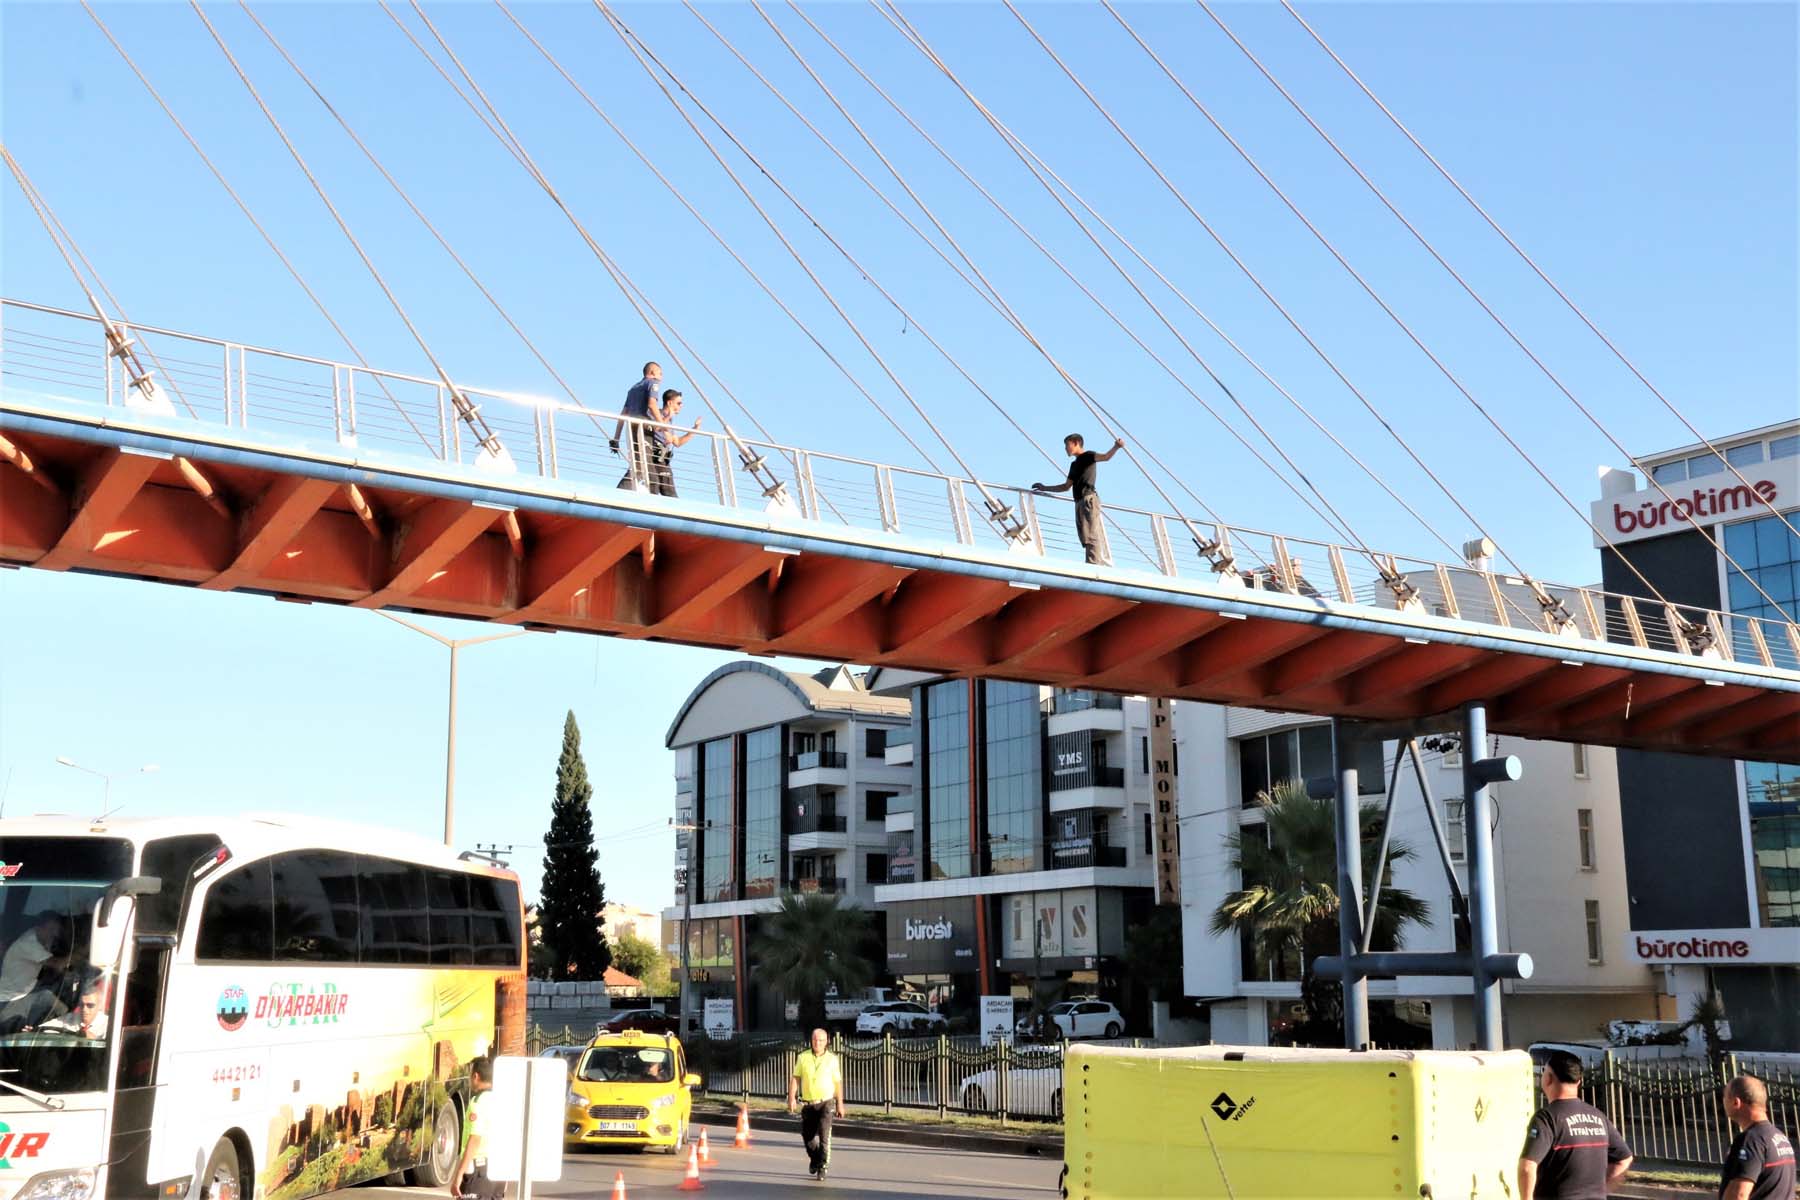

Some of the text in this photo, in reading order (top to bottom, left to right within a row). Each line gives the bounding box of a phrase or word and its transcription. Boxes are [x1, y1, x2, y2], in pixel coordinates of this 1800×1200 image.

[1613, 480, 1777, 534] bürotime
[1058, 752, 1082, 766] YMS
[1155, 760, 1174, 893] MOBİLYA
[1636, 936, 1749, 959] bürotime
[1232, 1096, 1255, 1121] vetter
[1565, 1113, 1604, 1128] ANTALYA
